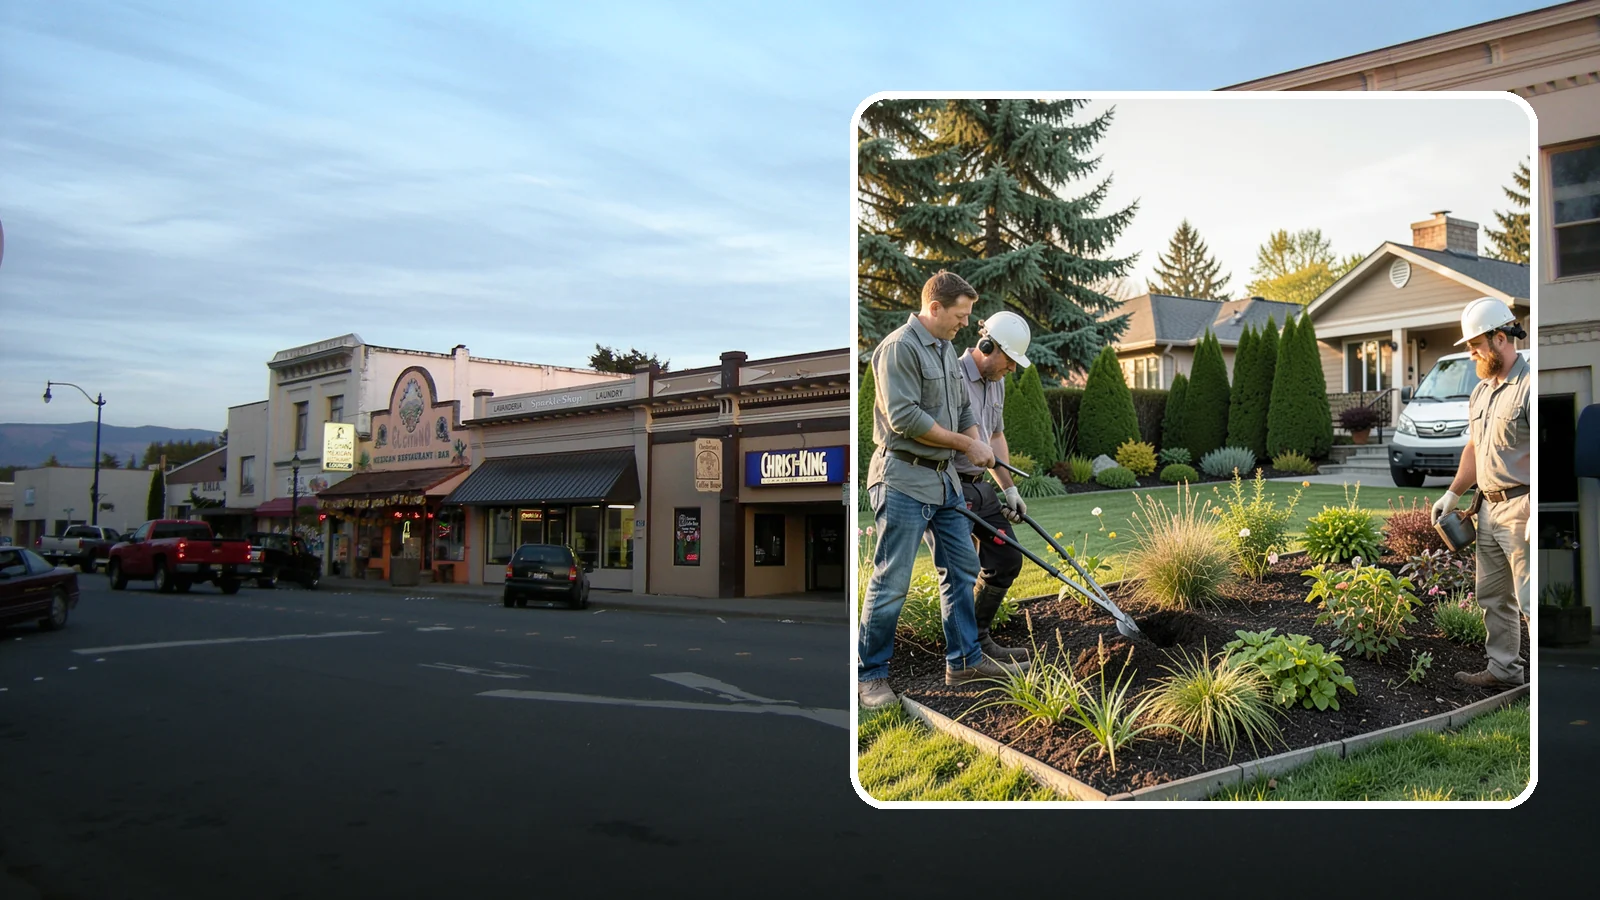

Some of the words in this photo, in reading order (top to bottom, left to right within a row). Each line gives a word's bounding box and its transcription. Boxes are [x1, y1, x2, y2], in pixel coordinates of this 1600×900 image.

[595, 389, 624, 400] LAUNDRY
[493, 402, 523, 413] LAVANDERIA
[530, 397, 561, 410] Sparkle
[562, 394, 582, 408] Shop
[373, 455, 396, 464] MEXICAN
[397, 451, 433, 462] RESTAURANT
[437, 450, 450, 459] BAR
[760, 452, 797, 478] CHRIST
[799, 450, 827, 476] KING
[696, 481, 709, 489] Coffee
